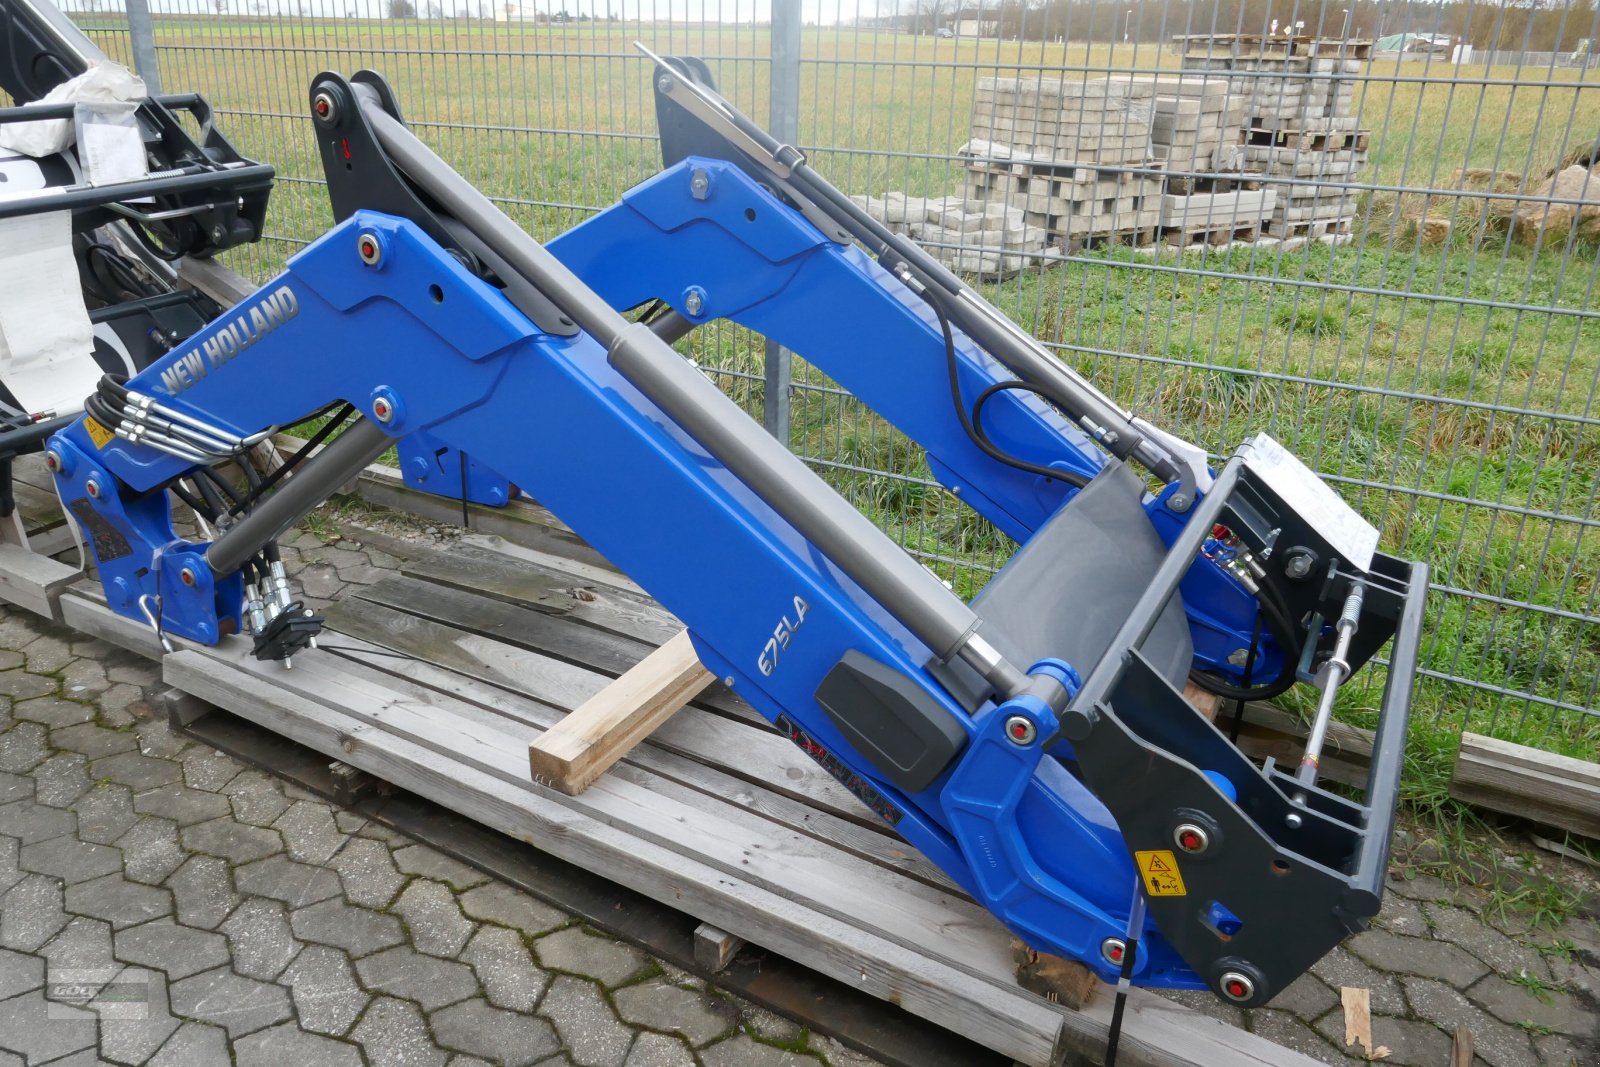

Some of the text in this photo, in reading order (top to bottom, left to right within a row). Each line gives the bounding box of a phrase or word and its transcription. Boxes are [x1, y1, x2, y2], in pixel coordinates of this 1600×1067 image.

[160, 285, 299, 396] NEW HOLLAND
[757, 595, 811, 677] 675LA
